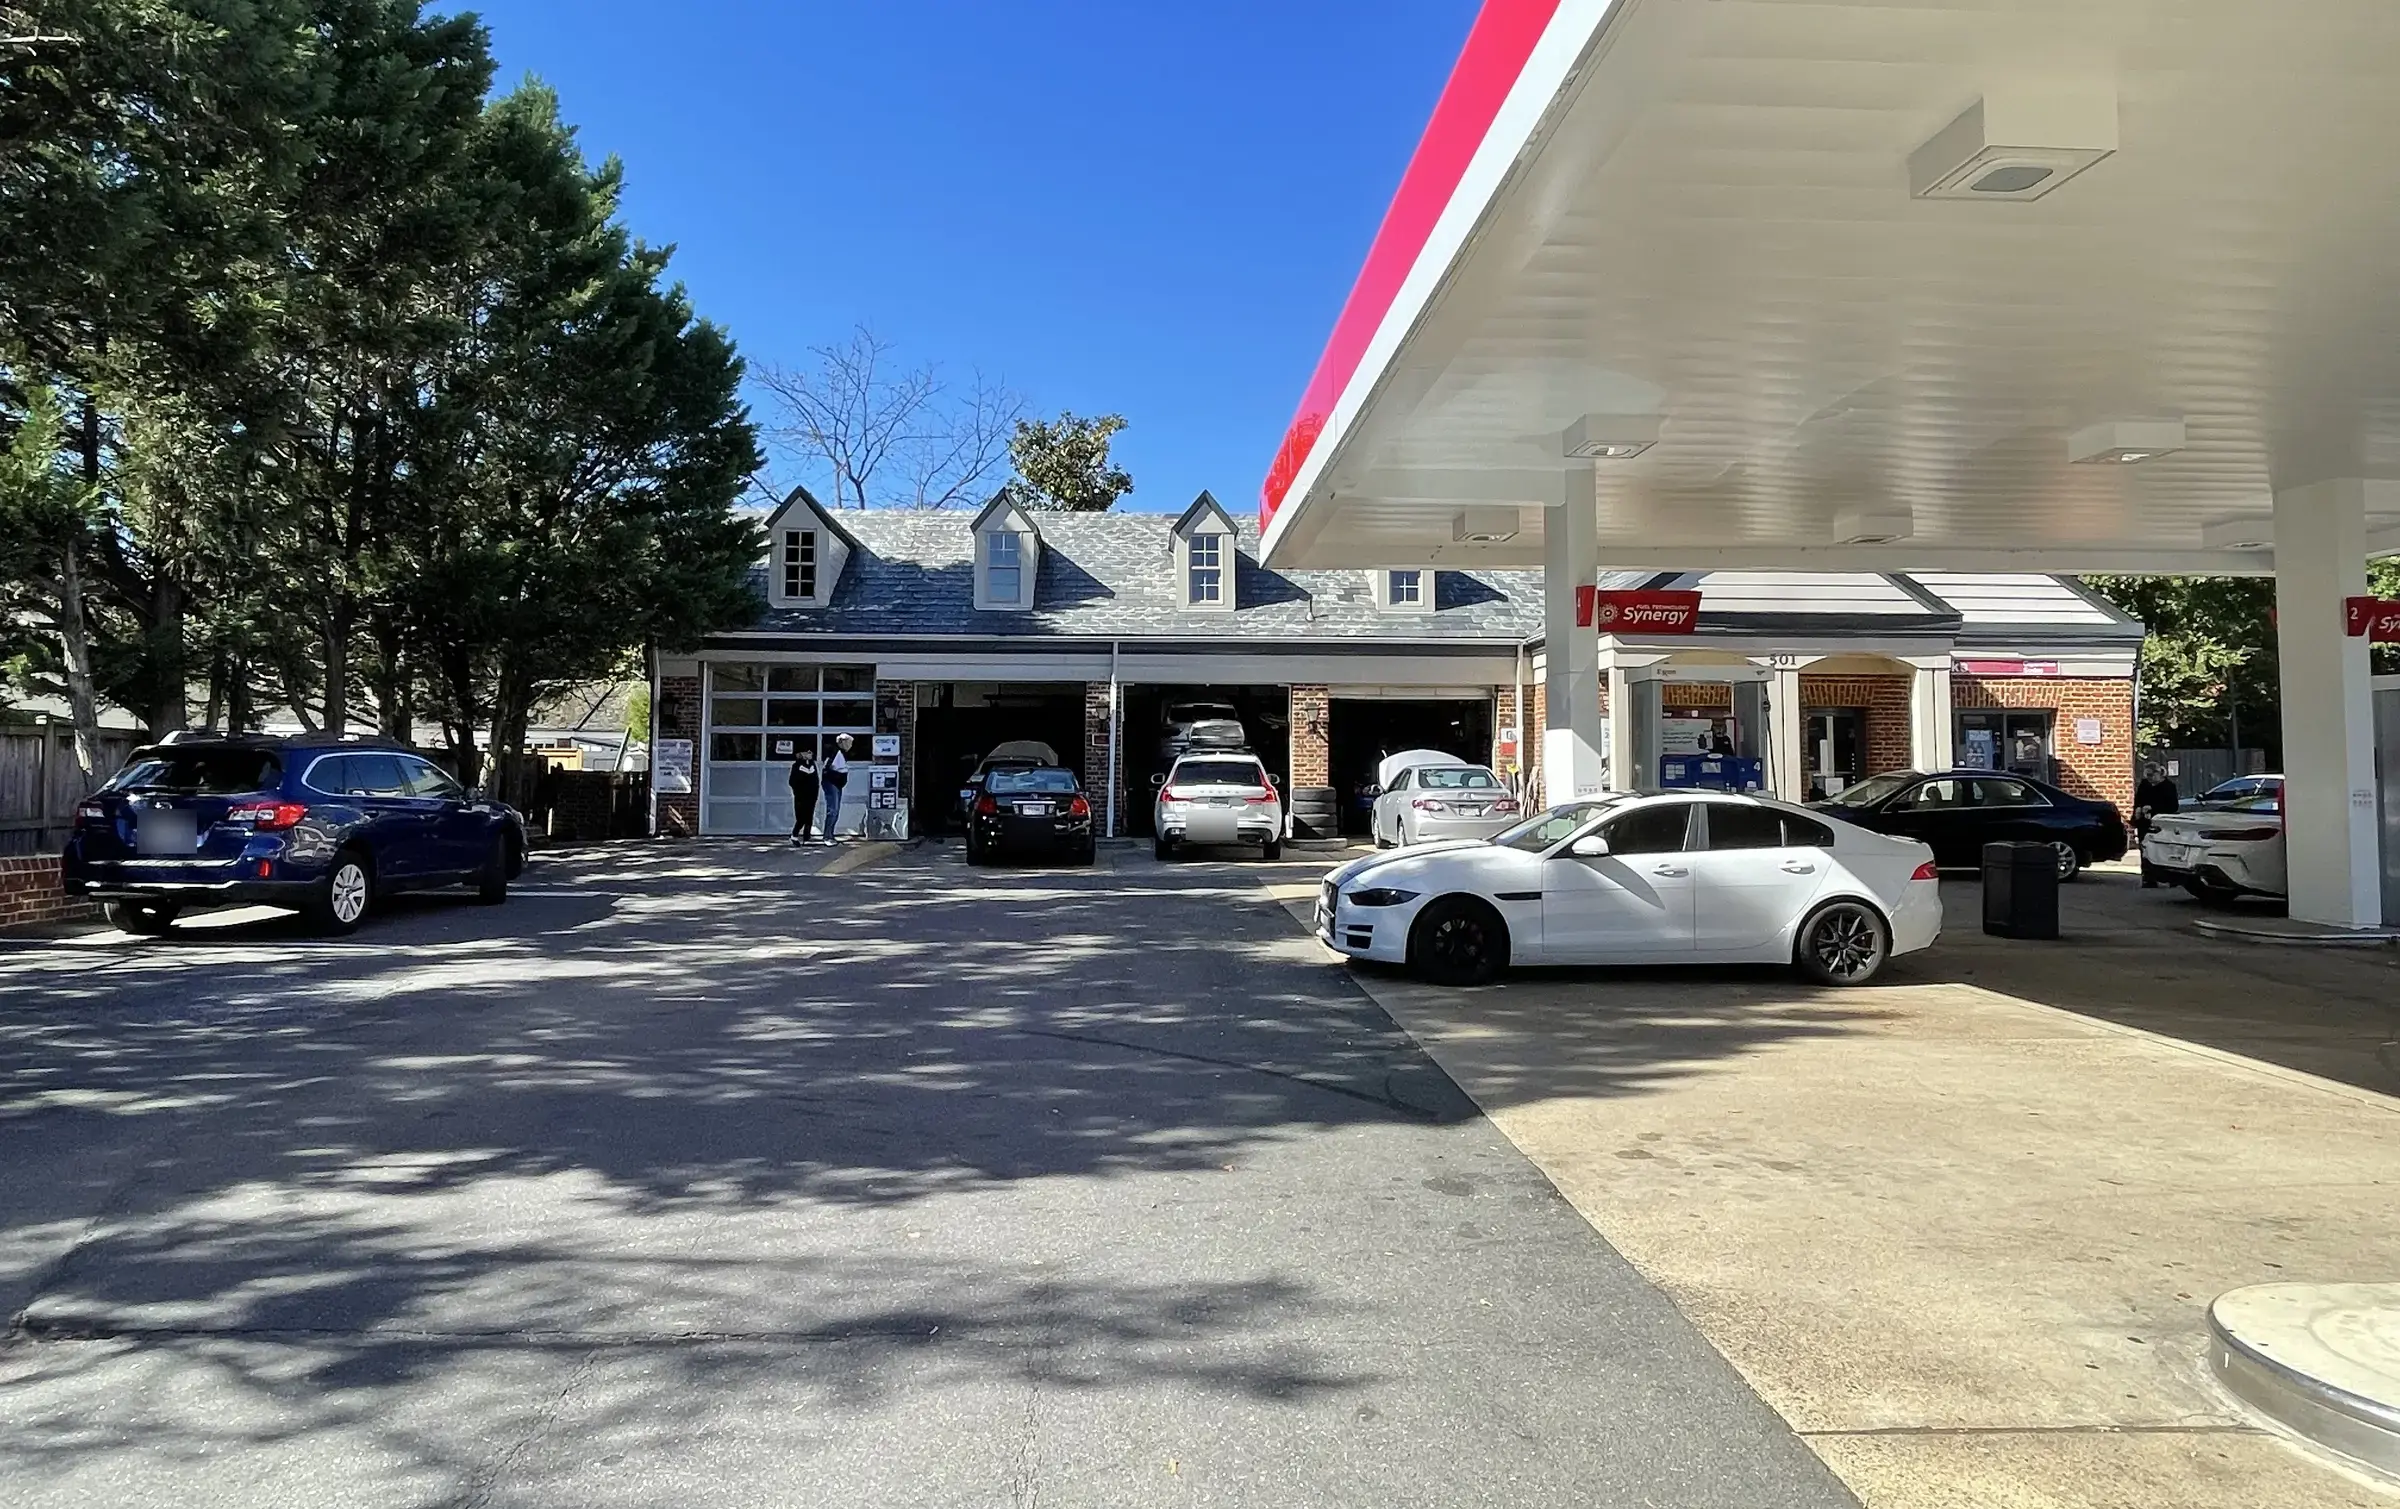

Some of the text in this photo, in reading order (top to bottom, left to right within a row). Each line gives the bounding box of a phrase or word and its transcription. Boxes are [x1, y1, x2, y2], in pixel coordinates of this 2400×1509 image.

[1623, 607, 1689, 625] Synergy
[2350, 606, 2359, 620] 2
[1769, 653, 1796, 666] 501
[1753, 761, 1761, 772] 4
